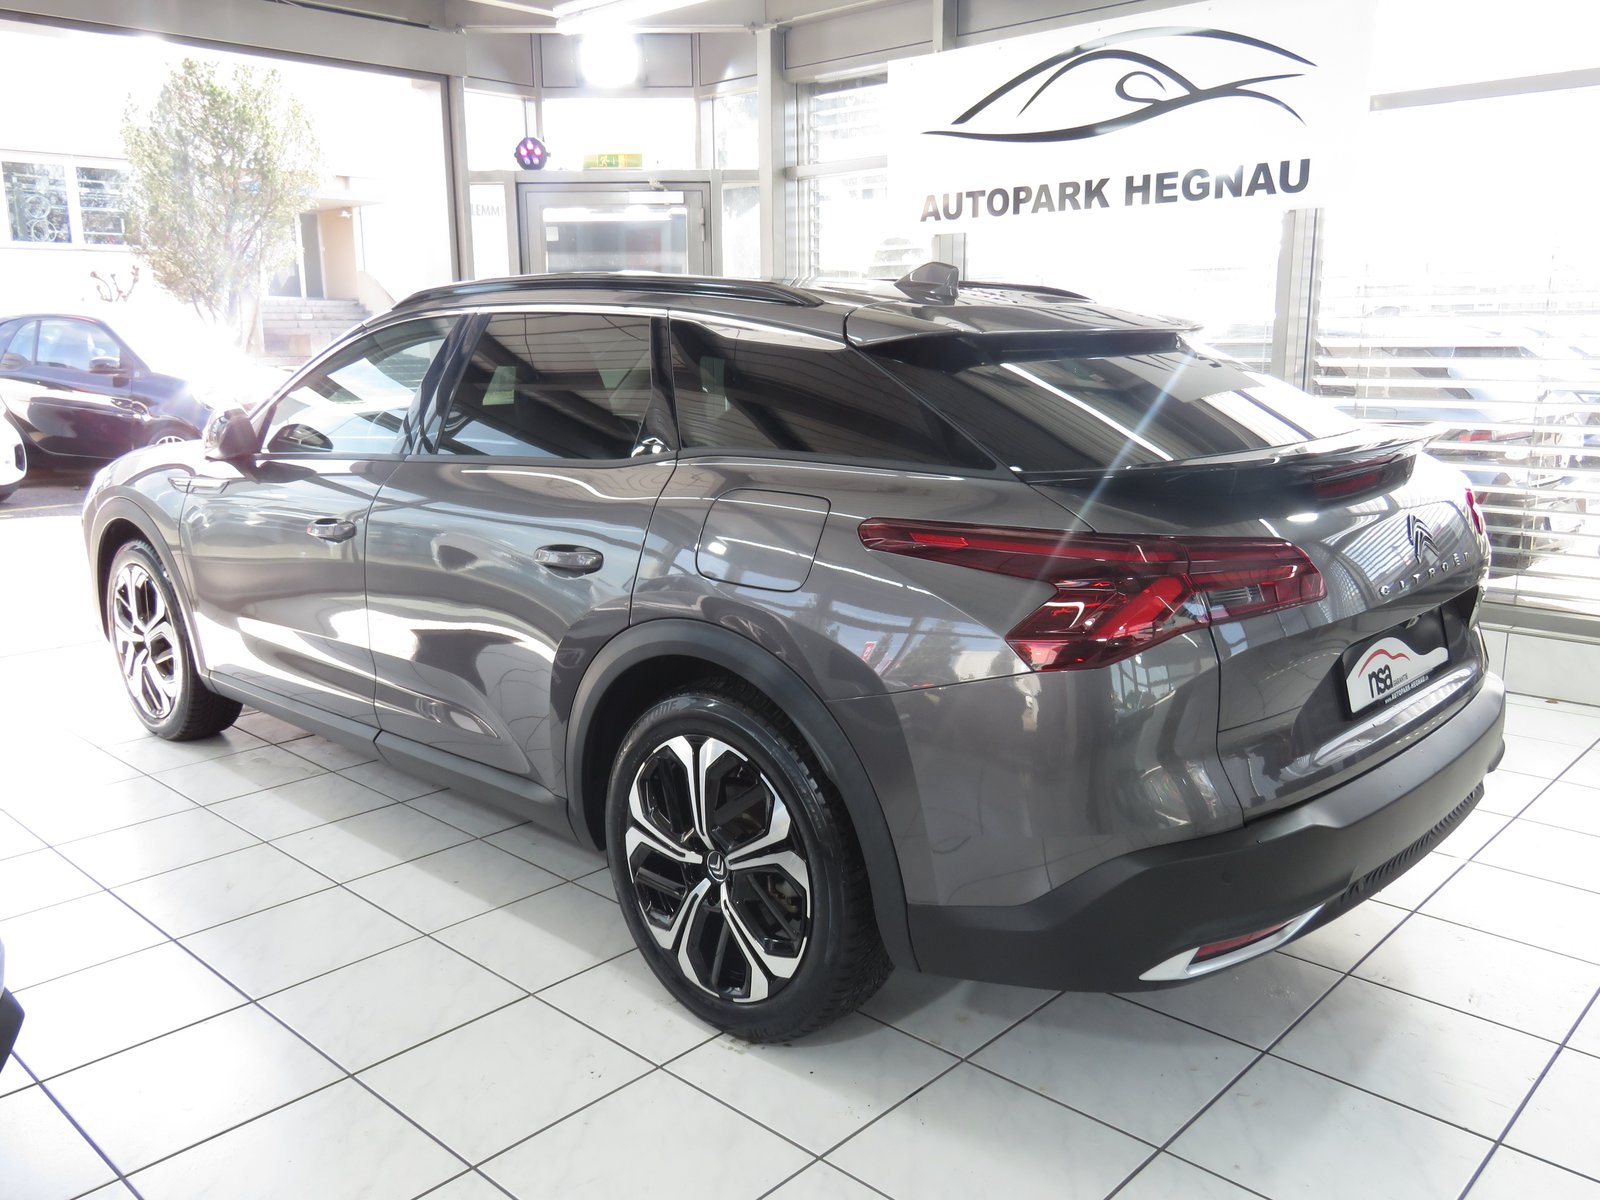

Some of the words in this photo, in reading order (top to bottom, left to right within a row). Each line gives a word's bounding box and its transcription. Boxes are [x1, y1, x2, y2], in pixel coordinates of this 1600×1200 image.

[920, 177, 1110, 222] AUTOPARK
[1124, 158, 1311, 206] HEGNAU
[1368, 664, 1393, 698] nsa
